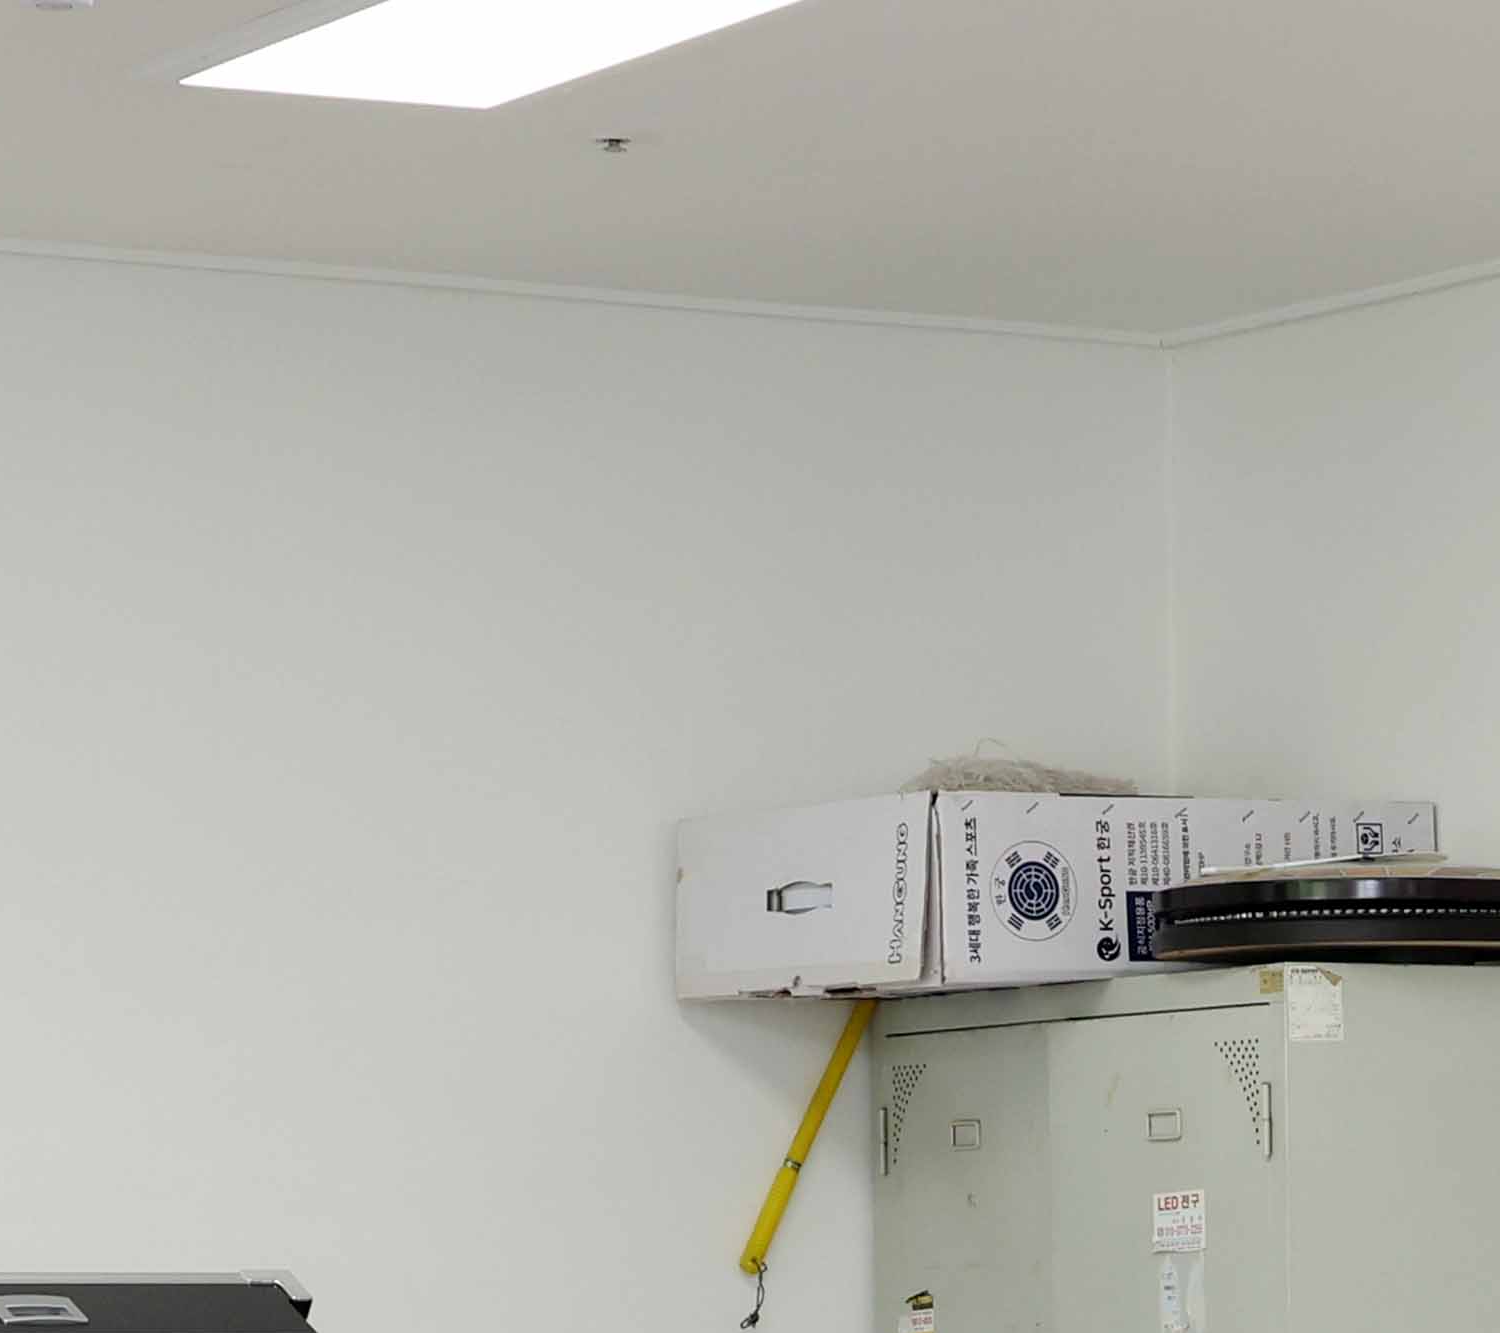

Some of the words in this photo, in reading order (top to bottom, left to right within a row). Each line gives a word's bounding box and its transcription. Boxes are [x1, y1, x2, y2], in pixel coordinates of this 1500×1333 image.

[964, 817, 978, 856] 스포츠
[1096, 819, 1111, 851] 한궁
[965, 860, 979, 886] 가족
[887, 822, 909, 965] HANGUNG
[965, 888, 981, 927] 행복한
[1098, 855, 1117, 932] K-Sport
[967, 929, 981, 963] 3세대
[1157, 1196, 1179, 1212] LED
[1180, 1193, 1199, 1210] 전구
